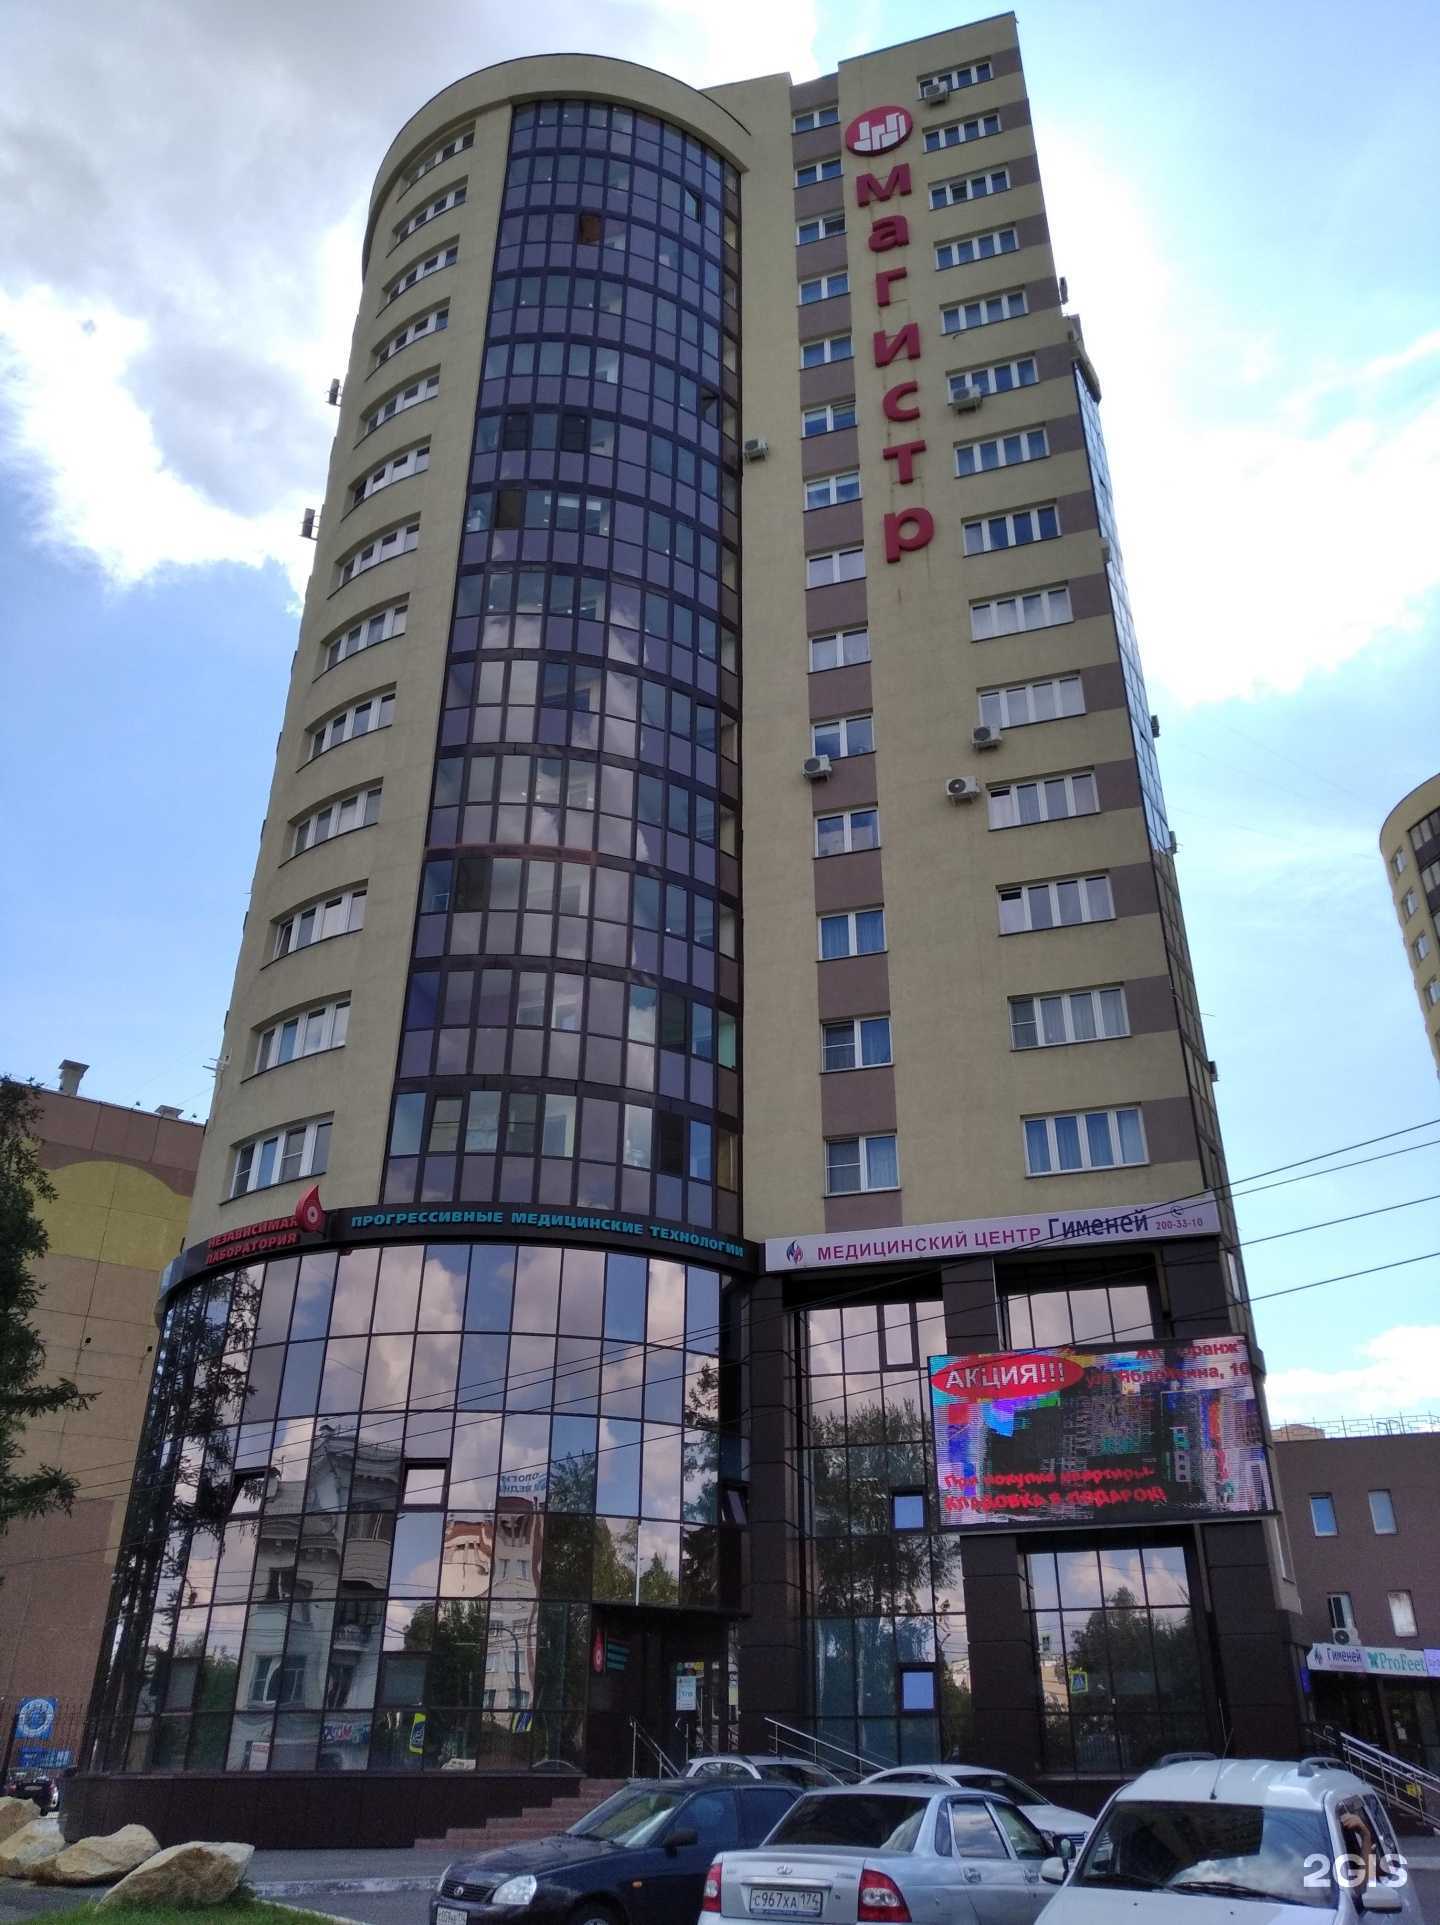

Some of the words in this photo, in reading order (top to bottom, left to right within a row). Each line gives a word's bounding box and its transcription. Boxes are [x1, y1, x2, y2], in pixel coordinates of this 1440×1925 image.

[206, 1232, 298, 1265] ЛАБОРАТОРИЯ
[351, 1211, 504, 1228] ПРОГРЕССИВНЫЕ
[511, 1212, 644, 1236] МЕДИЦИНСКИЕ
[649, 1225, 744, 1257] ТЕХНОЛОГИИ
[817, 1231, 968, 1261] МЕДИЦИНСКИЙ
[975, 1227, 1041, 1248] ЦЕНТР
[1048, 1208, 1149, 1239] Гименей
[1155, 1217, 1204, 1231] 200-33-10
[944, 1362, 1066, 1389] АКЦИЯ!!!
